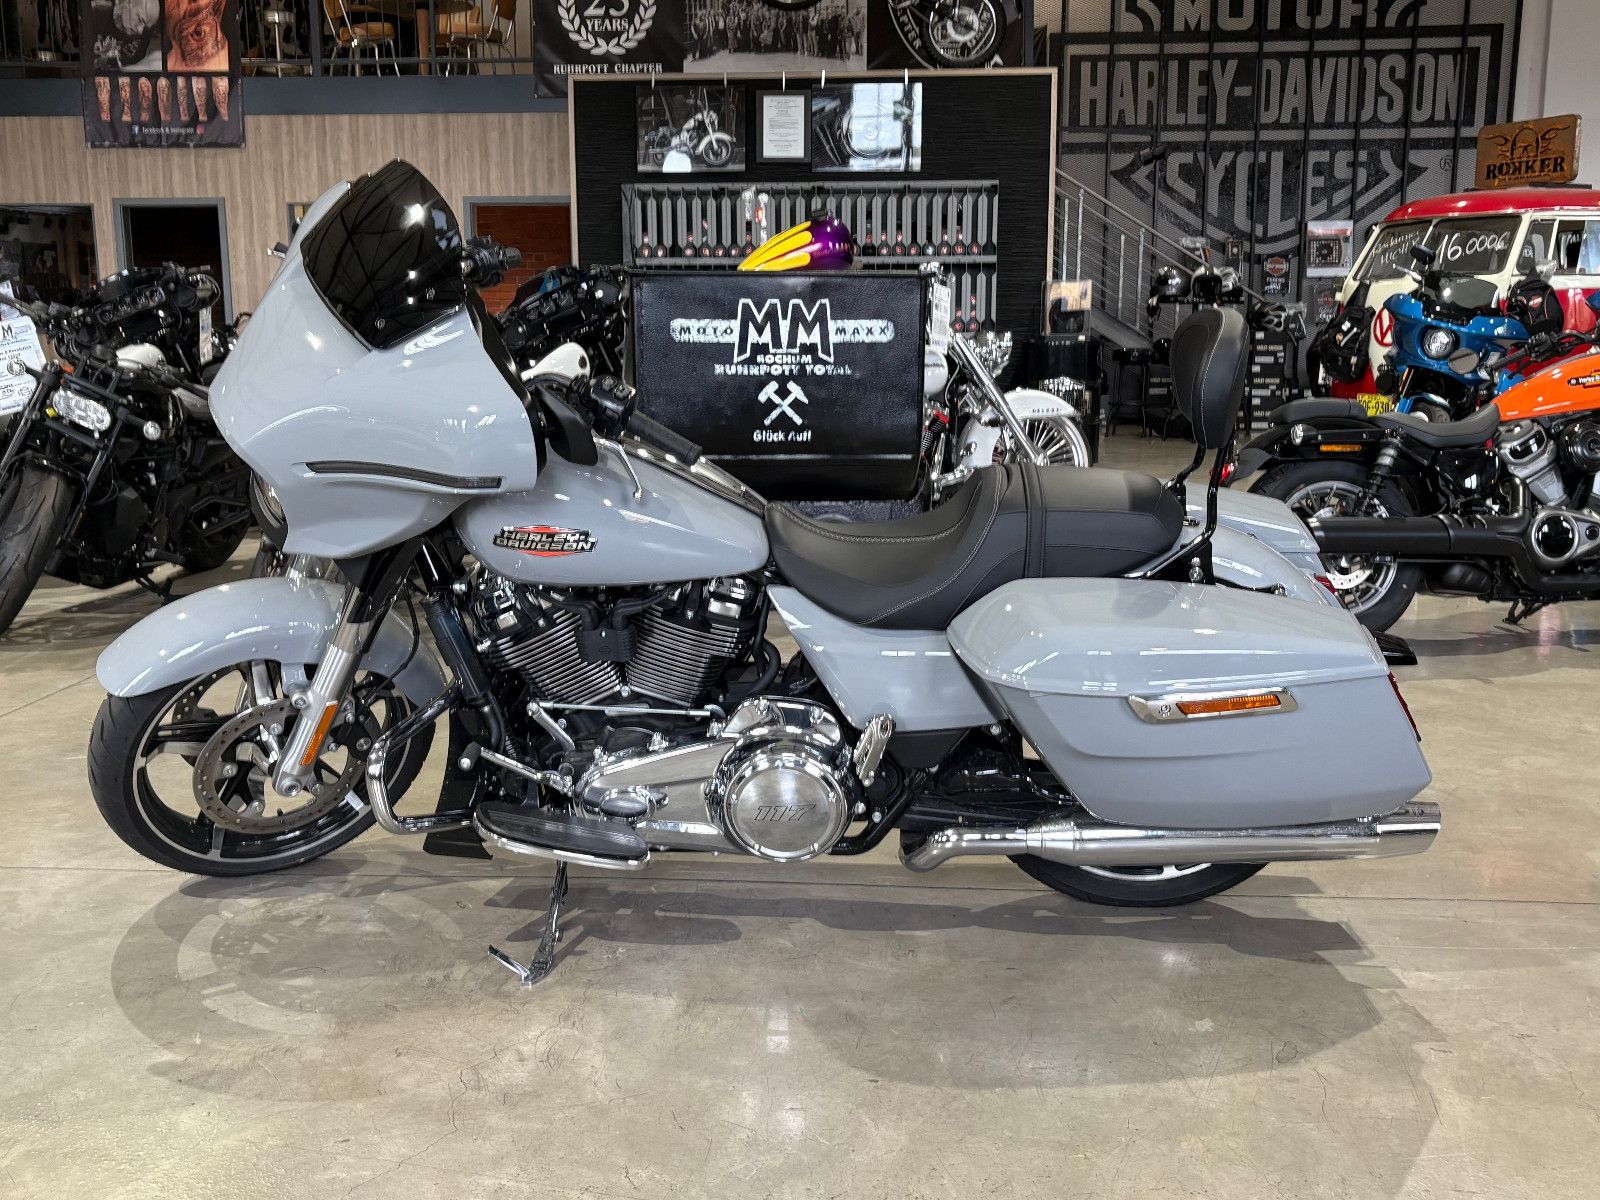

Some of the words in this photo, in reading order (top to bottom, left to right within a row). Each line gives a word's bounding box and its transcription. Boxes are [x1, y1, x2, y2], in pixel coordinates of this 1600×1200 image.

[585, 18, 629, 31] YEARS
[553, 63, 609, 75] RUHRPOTT
[614, 62, 664, 74] CHAPTER
[1079, 53, 1461, 126] HARLEY-DAVIDSON
[1485, 155, 1566, 180] ROKKER
[1165, 149, 1368, 236] CYCLES
[679, 325, 734, 336] MOTO
[834, 325, 887, 337] MAXX
[756, 354, 812, 364] BOCHUM
[805, 363, 853, 376] TOTAL
[753, 429, 785, 442] Glück
[495, 537, 594, 552] DAVIDSON
